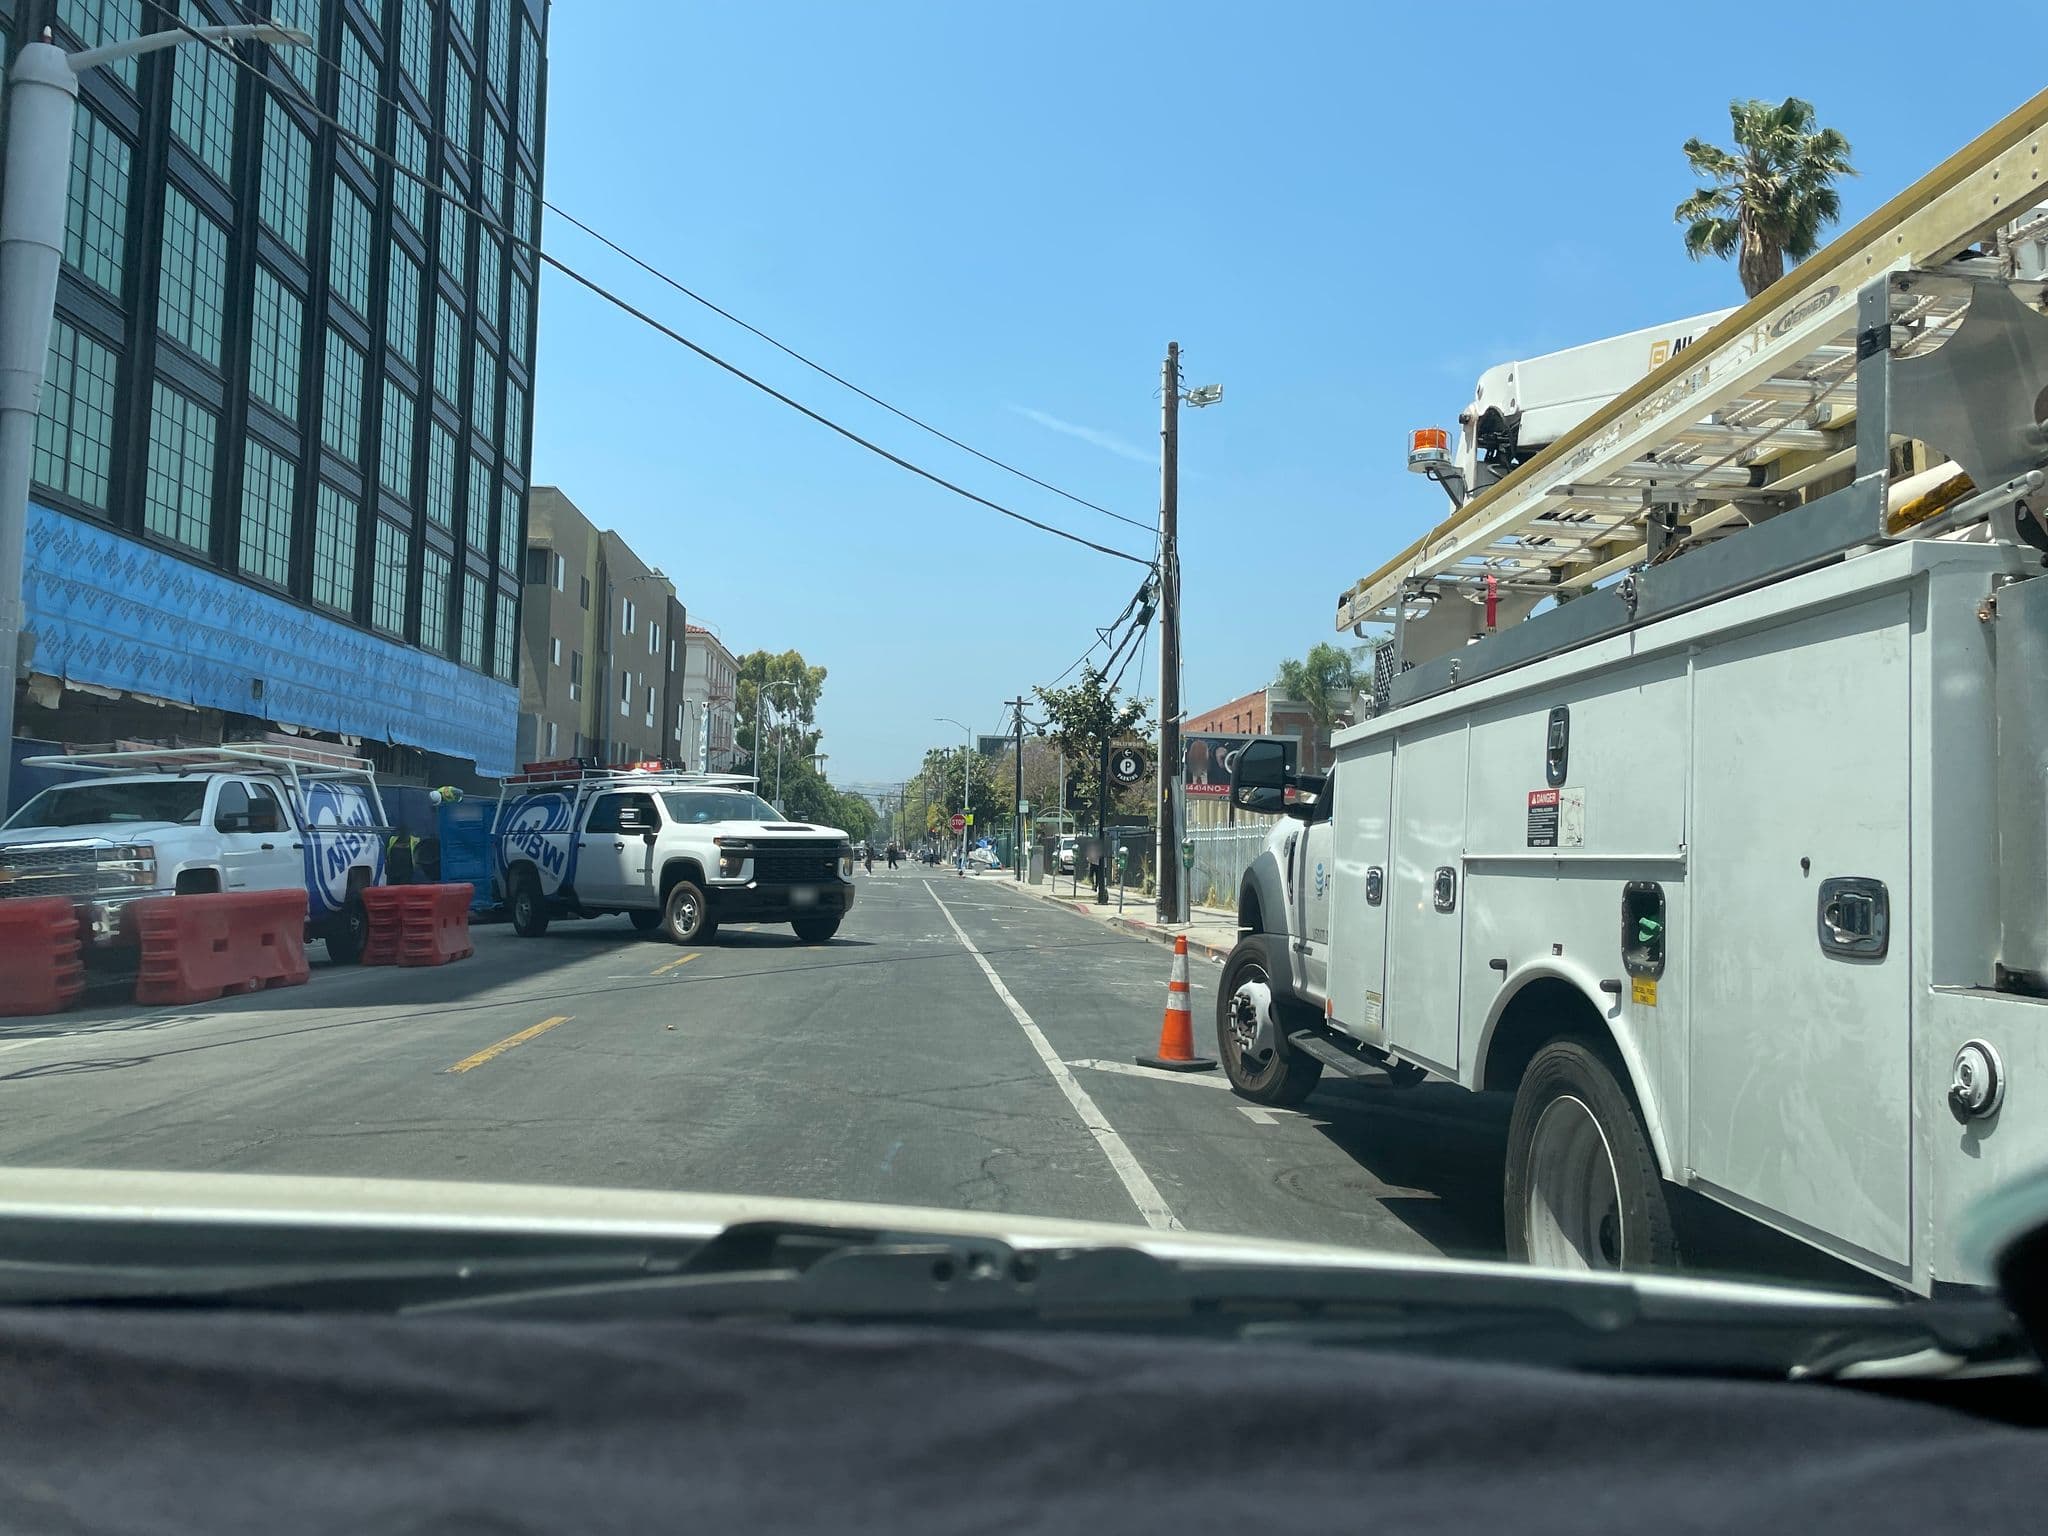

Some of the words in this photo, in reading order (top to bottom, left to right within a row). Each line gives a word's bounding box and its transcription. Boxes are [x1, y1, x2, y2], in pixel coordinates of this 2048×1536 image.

[1781, 292, 1831, 331] WERNER
[1125, 760, 1132, 772] P
[1116, 773, 1139, 782] PARKING
[1536, 792, 1557, 804] DANGER
[951, 818, 965, 826] STOP
[512, 819, 565, 876] MBW
